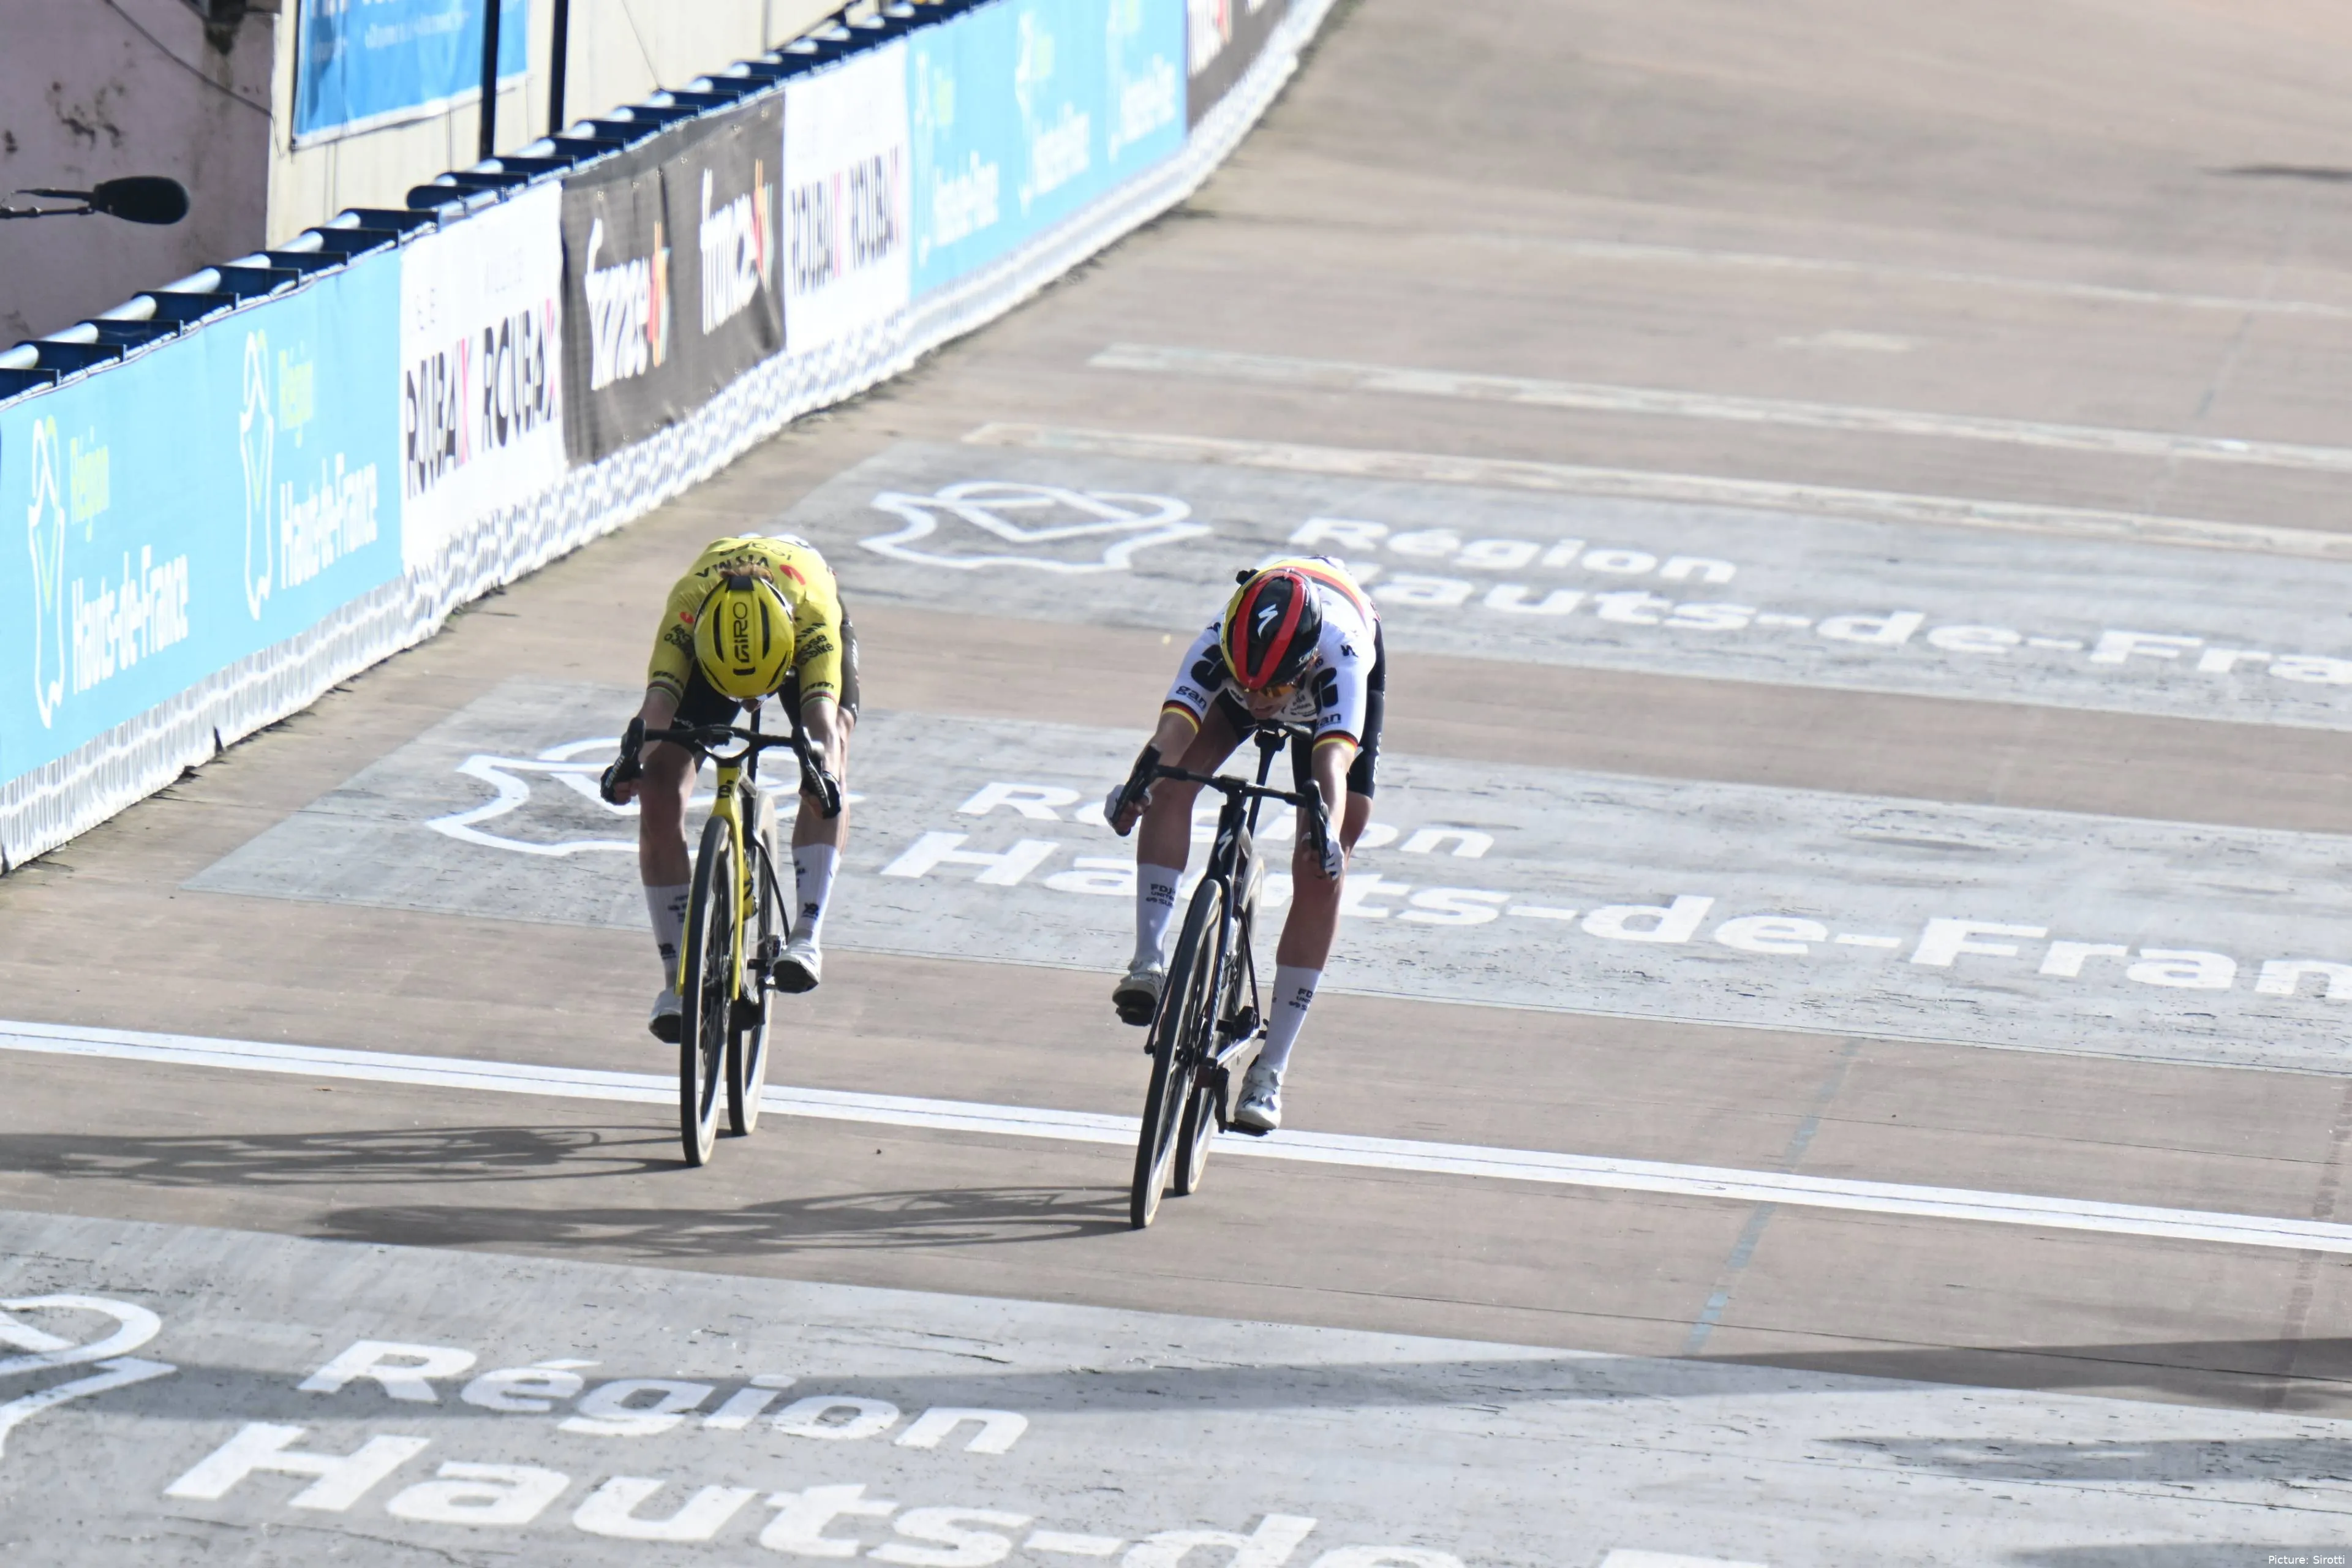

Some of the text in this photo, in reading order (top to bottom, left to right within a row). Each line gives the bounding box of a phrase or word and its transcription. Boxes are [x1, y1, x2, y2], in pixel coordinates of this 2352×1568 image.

[481, 298, 559, 453] ROUBAIX
[1287, 516, 1740, 586] Région
[70, 544, 190, 696] Hauts-de-France
[733, 601, 748, 664] GIRO
[296, 1339, 1029, 1455] Région
[163, 1421, 1771, 1568] Hauts-d
